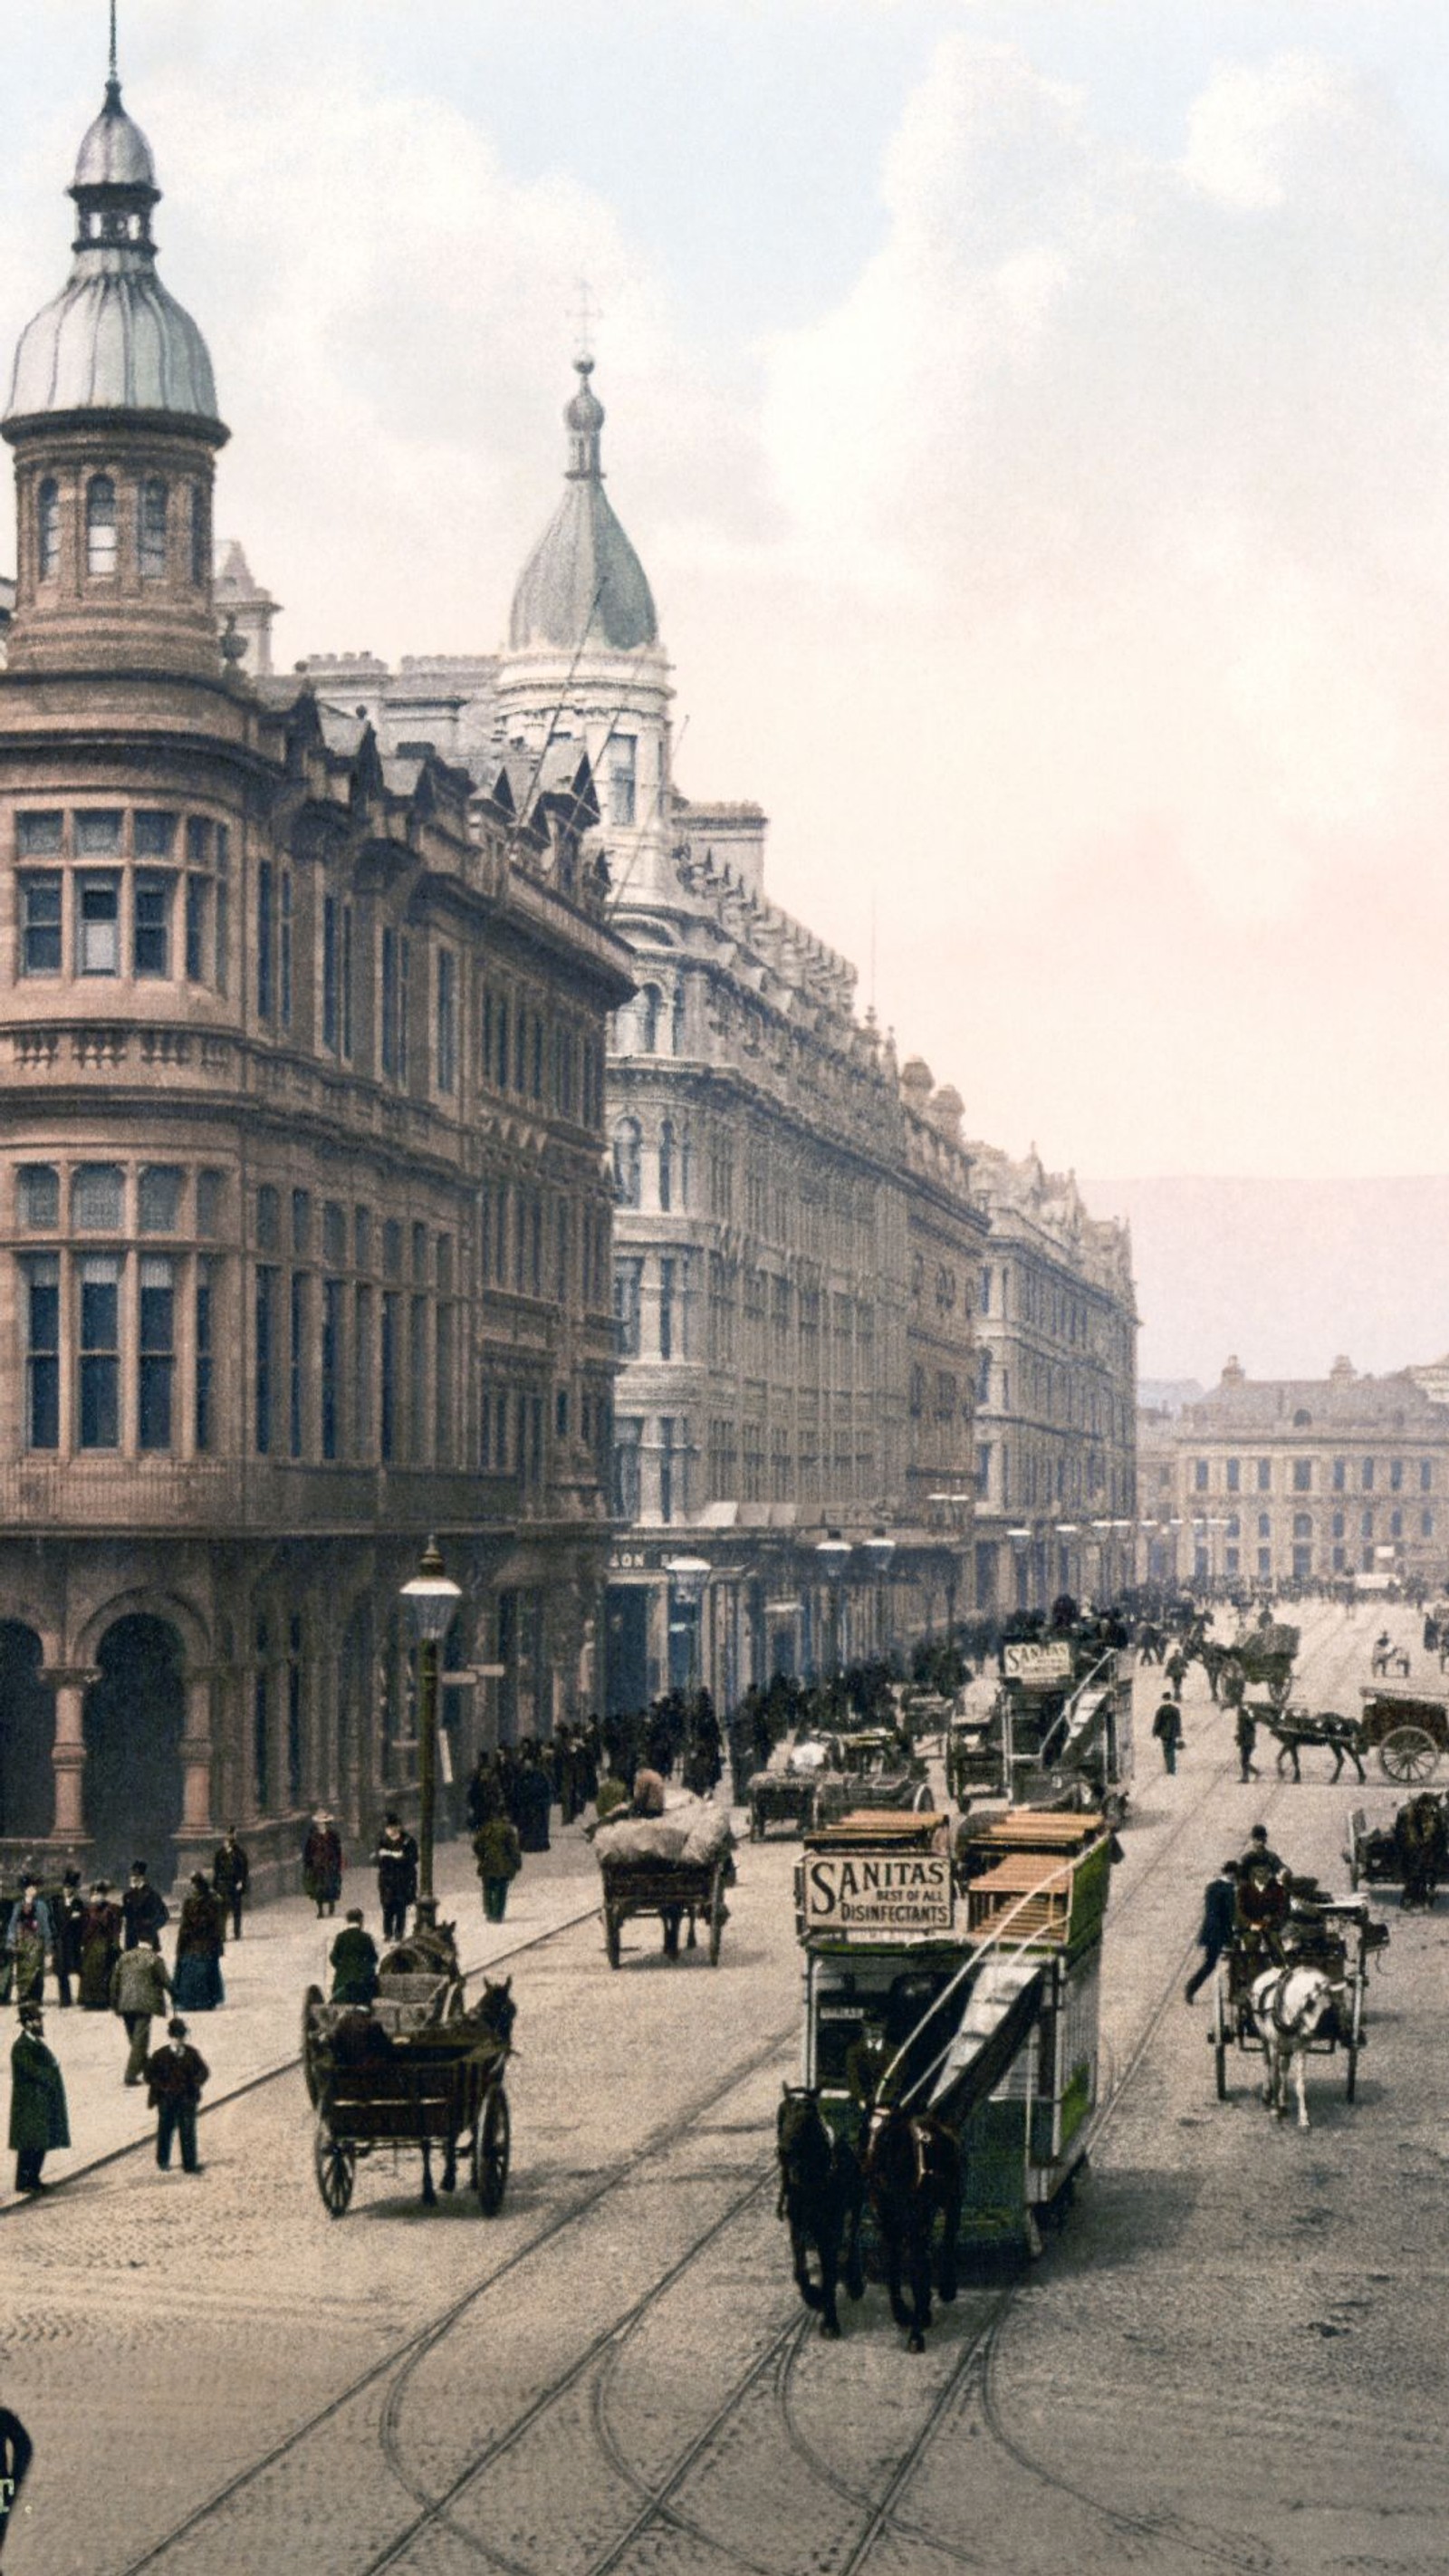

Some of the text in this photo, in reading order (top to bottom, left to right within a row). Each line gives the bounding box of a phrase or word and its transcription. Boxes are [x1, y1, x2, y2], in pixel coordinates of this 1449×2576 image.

[1007, 1647, 1067, 1672] SANAS
[876, 1889, 944, 1902] BEST OF ALL
[840, 1902, 948, 1922] DISINFECTANTS
